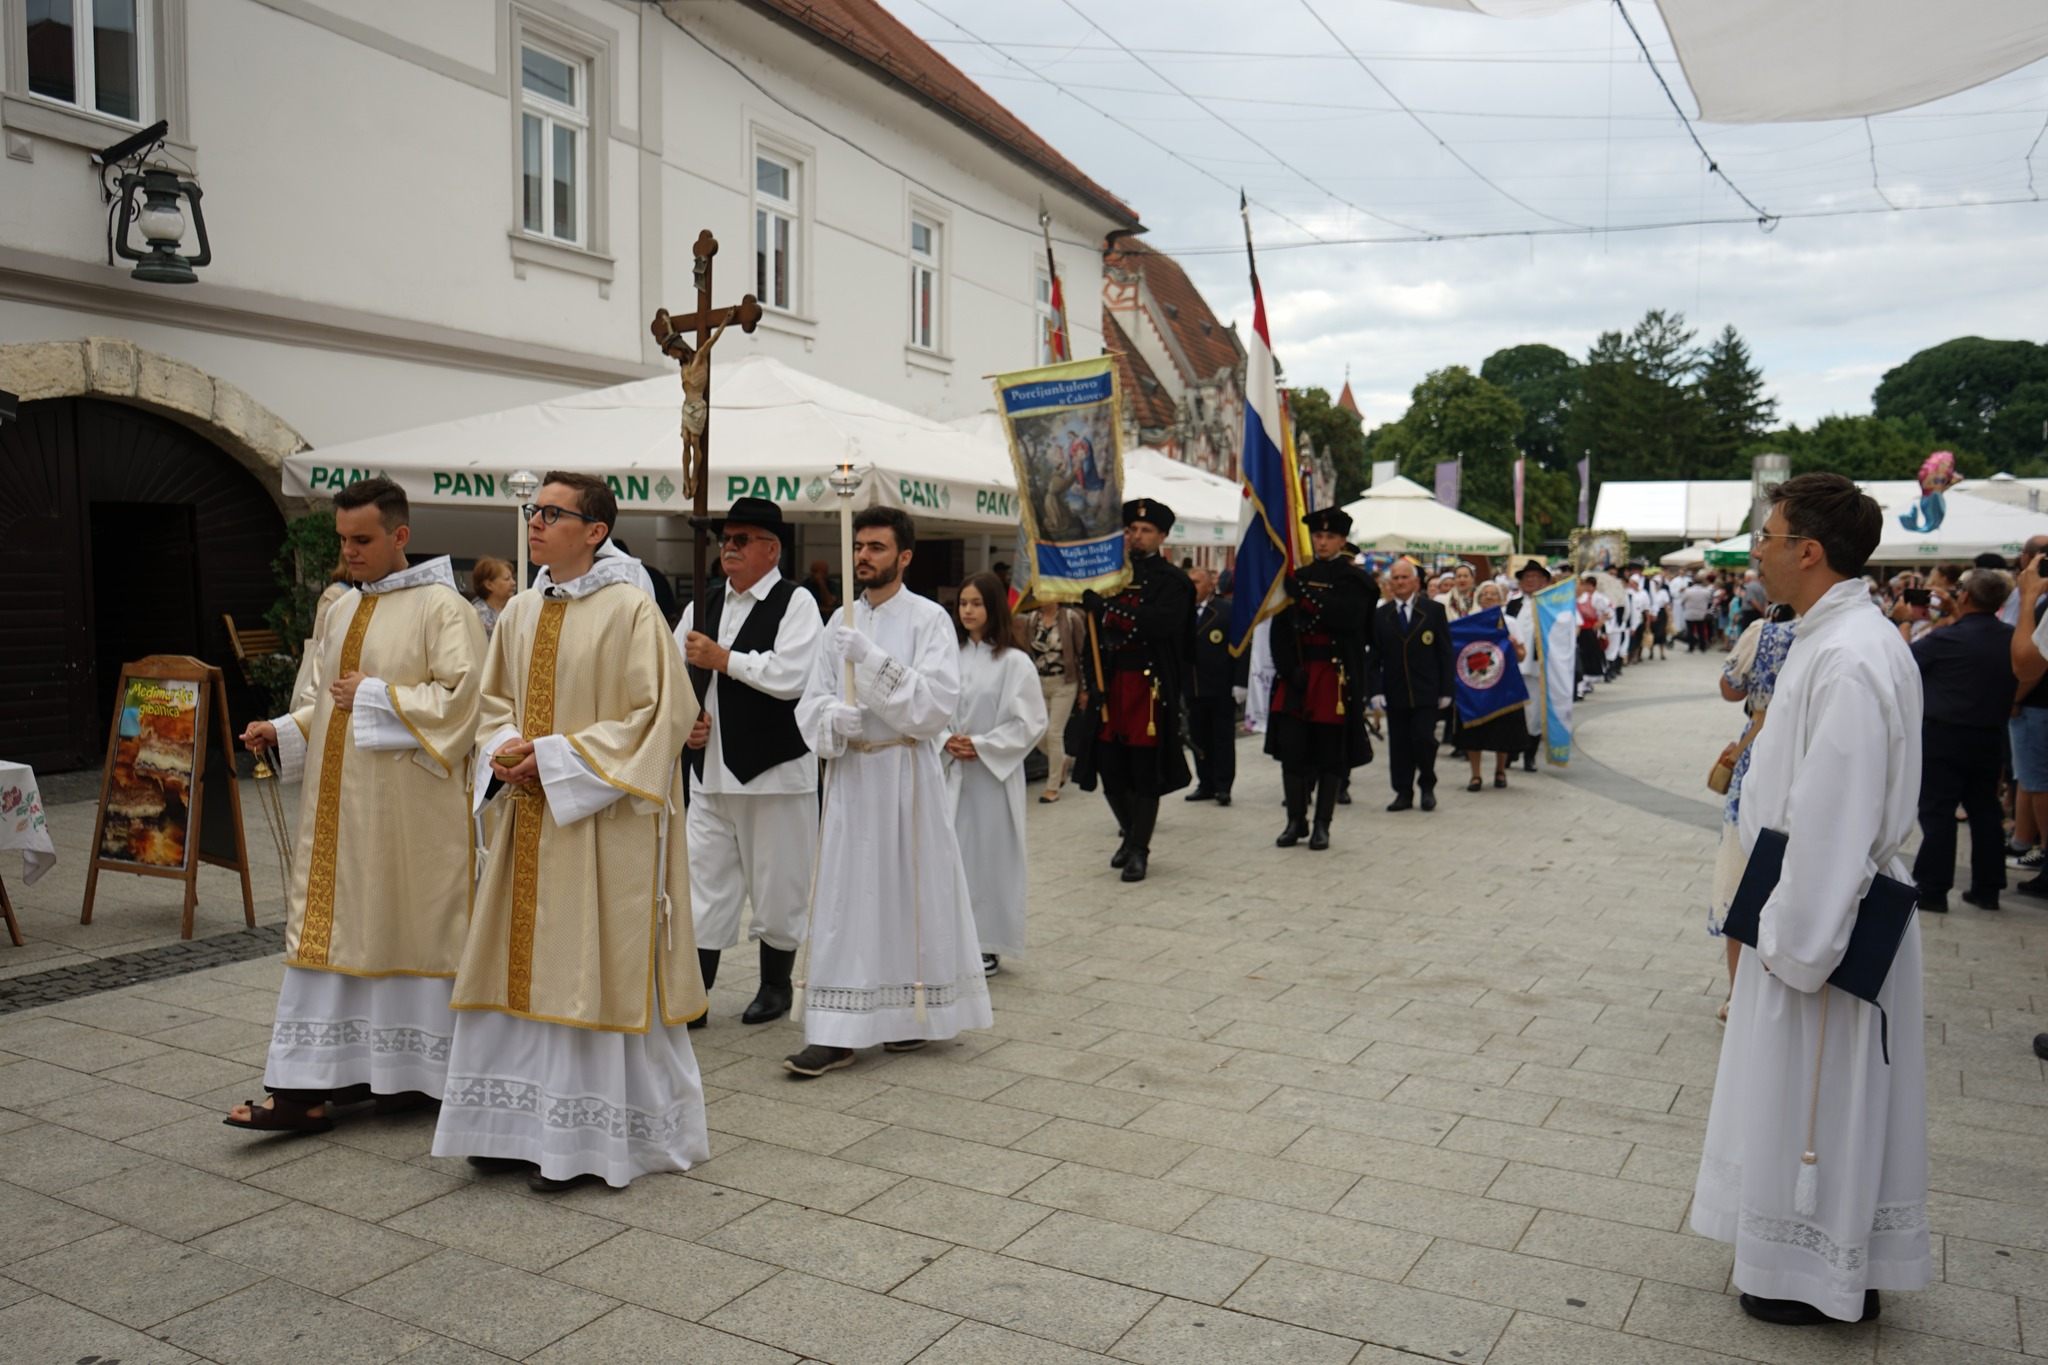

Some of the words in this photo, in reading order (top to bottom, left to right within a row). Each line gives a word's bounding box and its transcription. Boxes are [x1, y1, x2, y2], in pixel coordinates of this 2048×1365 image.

[1011, 379, 1098, 402] Porcijunkulovo
[310, 466, 370, 490] PAN
[433, 472, 495, 498] PAN
[607, 475, 649, 500] AN
[727, 475, 800, 501] PAN
[900, 479, 940, 509] PAN
[976, 490, 1011, 516] PAN
[1406, 542, 1430, 550] PAN
[138, 702, 180, 719] gibanica
